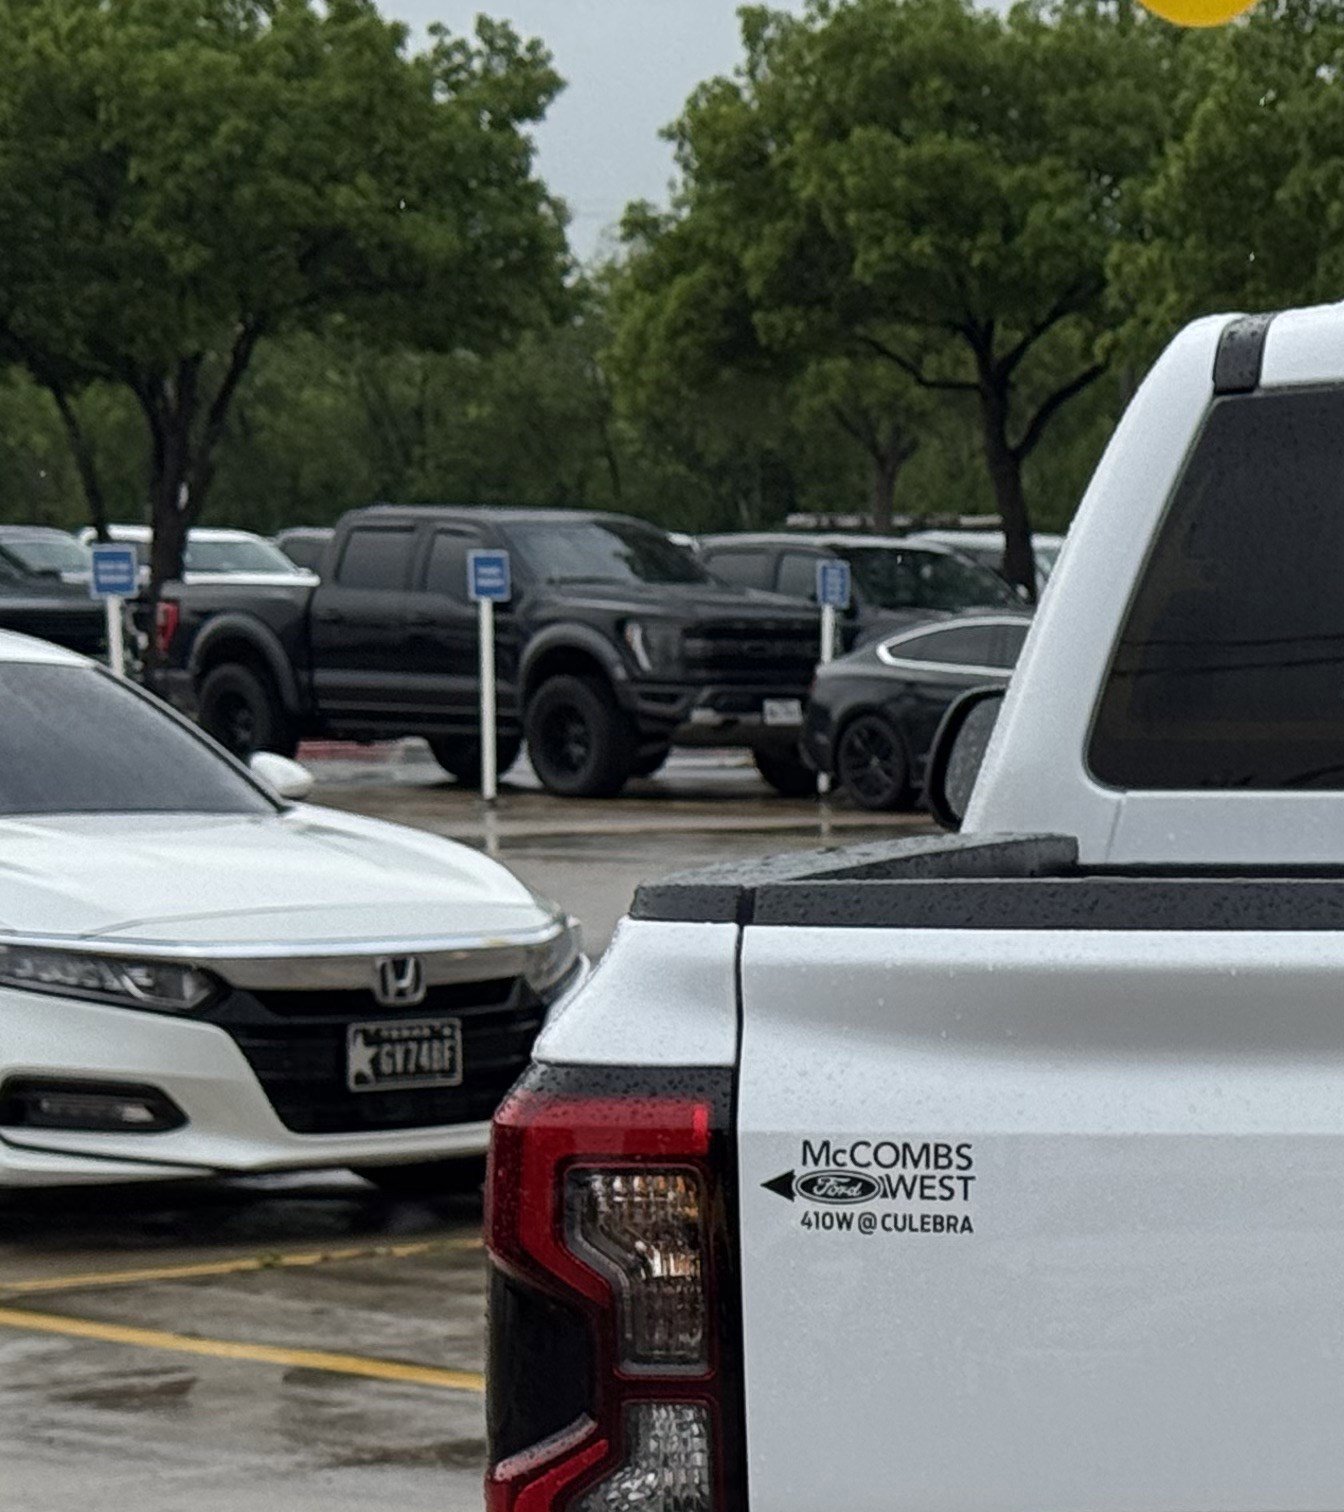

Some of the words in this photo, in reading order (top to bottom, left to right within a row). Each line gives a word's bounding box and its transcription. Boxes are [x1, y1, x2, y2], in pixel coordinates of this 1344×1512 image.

[801, 1139, 974, 1171] McCOMBS
[812, 1175, 863, 1197] Ford
[883, 1173, 976, 1202] WEST
